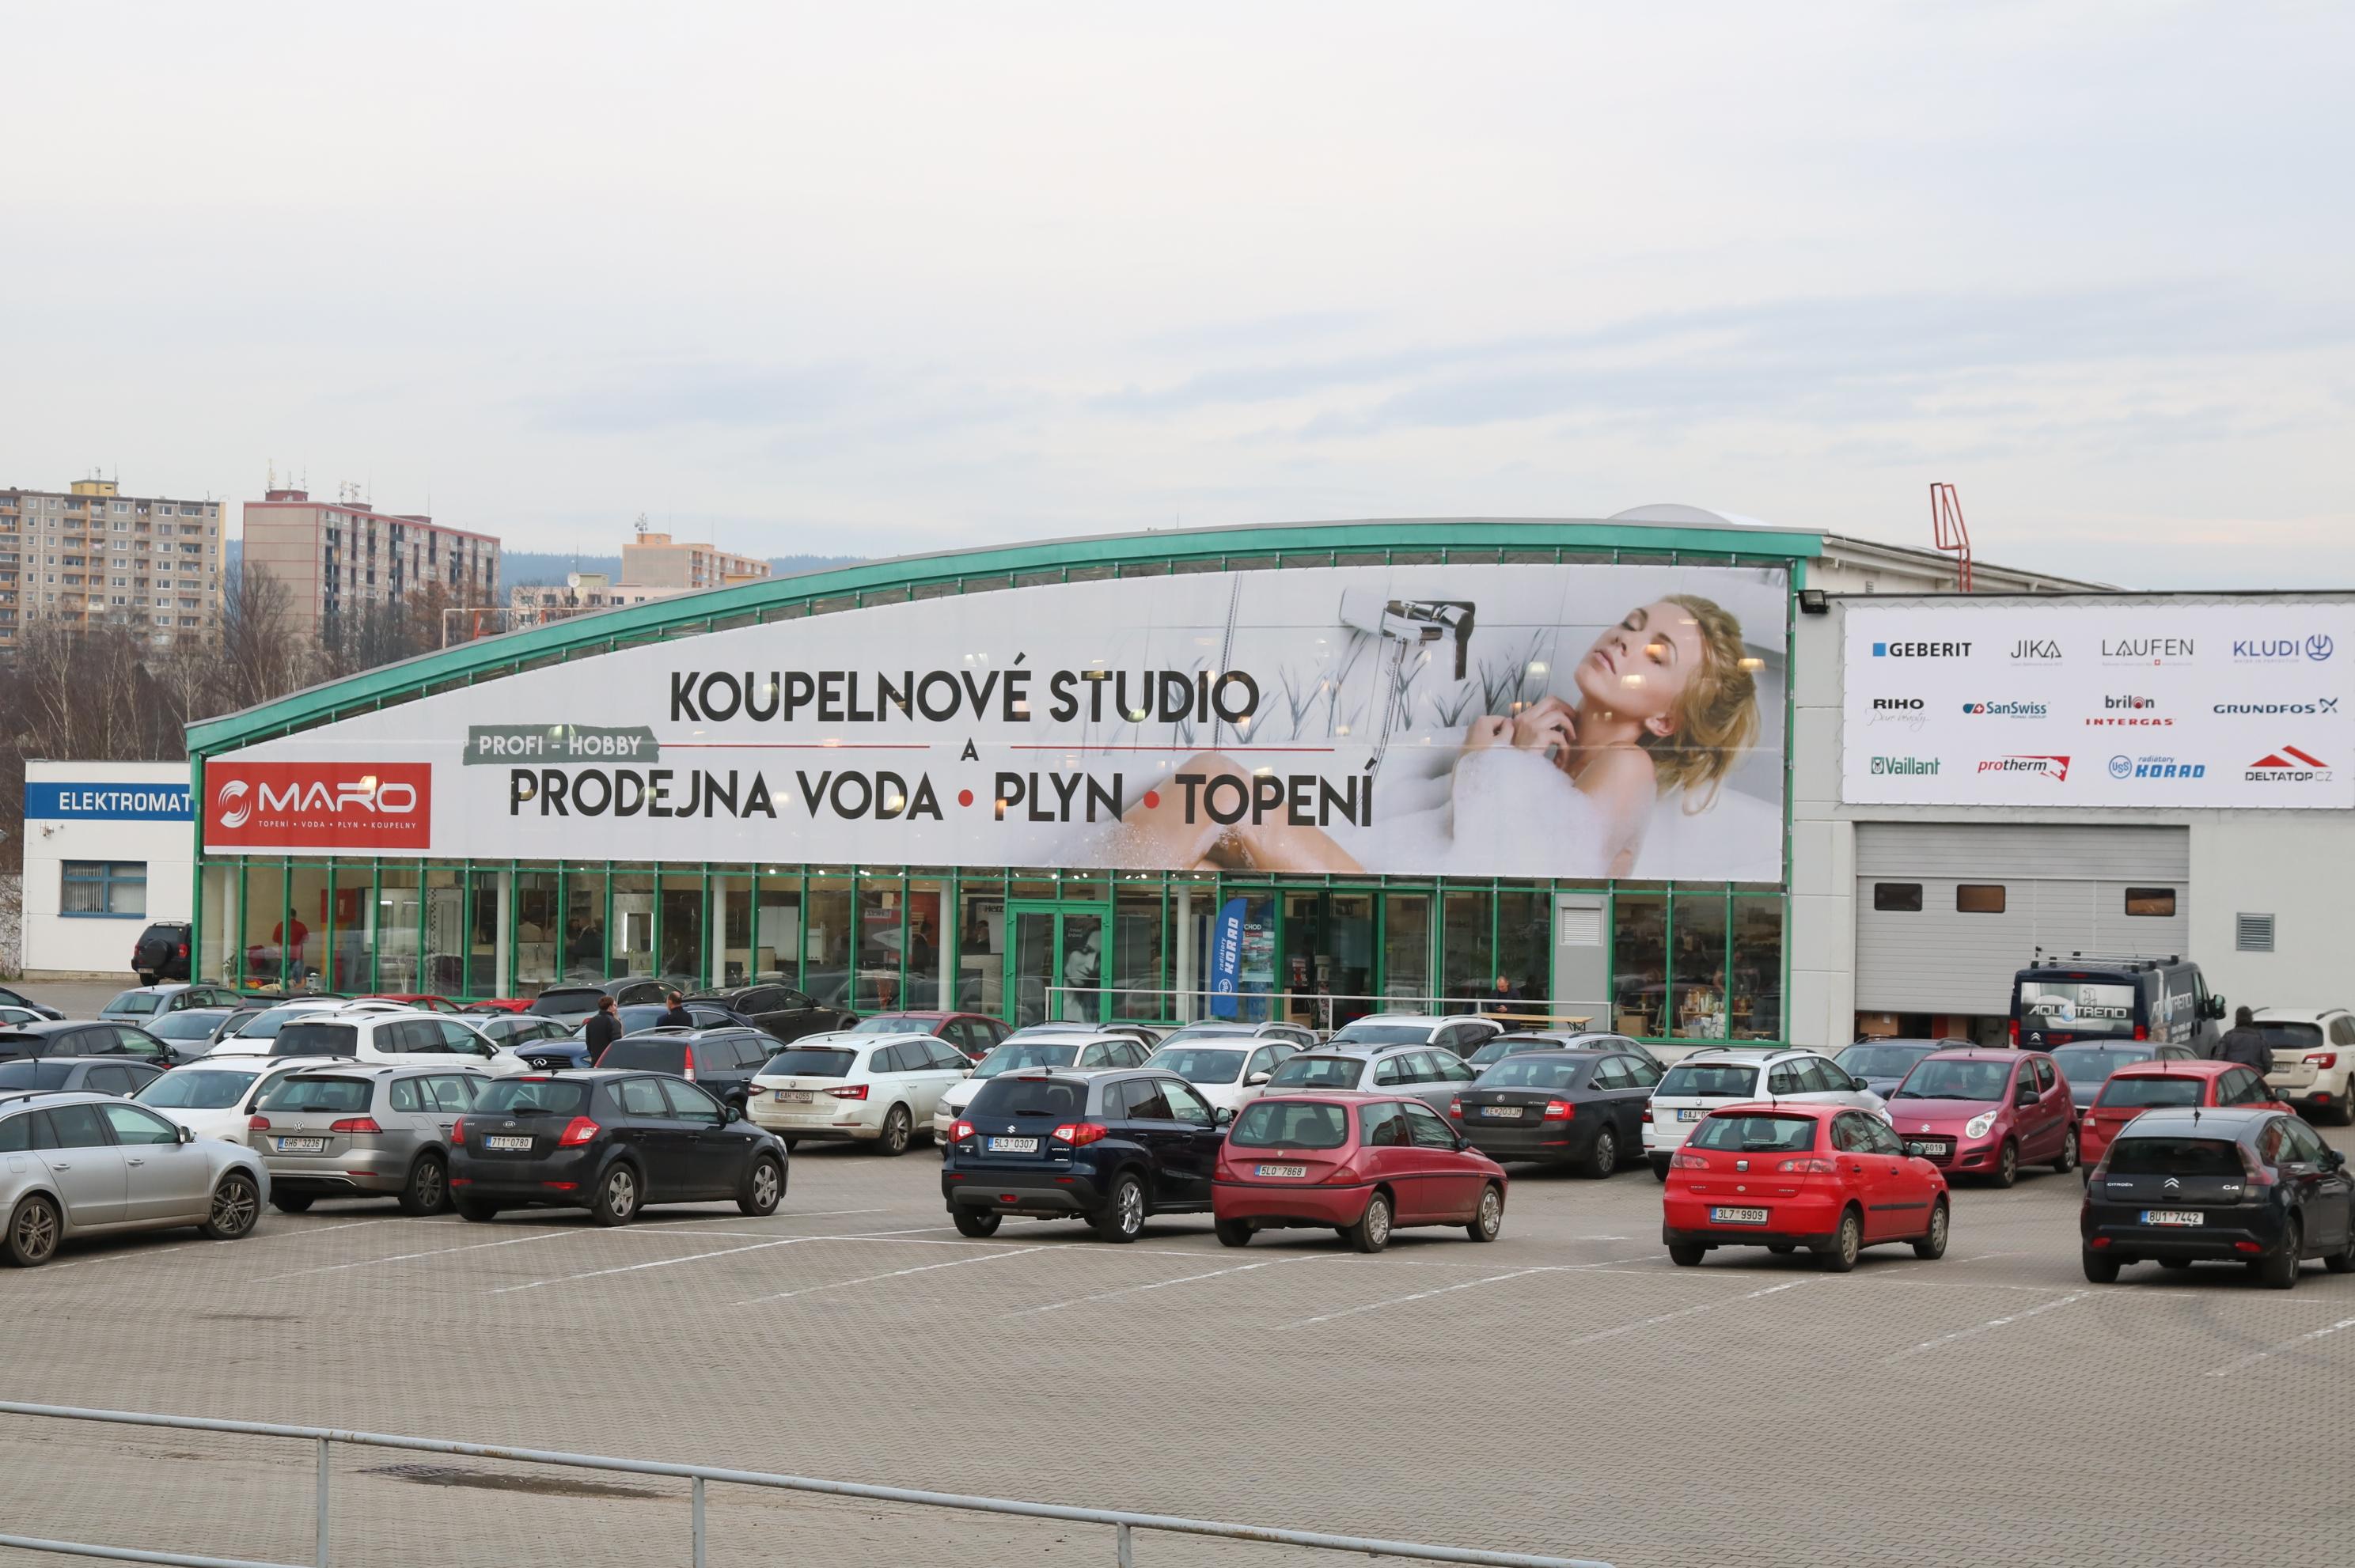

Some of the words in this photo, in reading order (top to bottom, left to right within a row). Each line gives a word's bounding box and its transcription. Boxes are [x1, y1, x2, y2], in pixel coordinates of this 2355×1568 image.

[1890, 642, 1972, 657] GEBERIT
[2011, 640, 2062, 658] JIKA
[2103, 639, 2194, 657] LAUFEN
[2234, 640, 2300, 657] KLUDI
[670, 651, 1032, 723] KOUPELNOVÉ
[1049, 669, 1260, 724] STUDIO
[1873, 699, 1925, 710] RIHO
[1986, 701, 2047, 714] SanSwiss
[2213, 704, 2316, 714] GRUNDFOS
[2086, 718, 2174, 726] INTERGAS
[480, 735, 544, 756] PROFI
[570, 735, 643, 756] HOBBY
[960, 737, 980, 761] A
[1886, 756, 1940, 775] Vaillant
[1978, 758, 2048, 774] protherm
[2138, 755, 2175, 764] radiatory
[2135, 764, 2206, 778] KORAD
[259, 781, 416, 813] MARO
[510, 768, 777, 819] PRODEJNA
[796, 770, 944, 821] VODA
[995, 771, 1123, 823] PLYN
[1175, 756, 1377, 828] TOPENÍ
[59, 791, 191, 813] ELEKTROMAT
[371, 821, 417, 830] KOUPELNY
[1224, 917, 1239, 975] KORAD
[285, 1138, 298, 1147] 6H6
[302, 1139, 320, 1148] 3236
[492, 1138, 506, 1147] 7T1
[510, 1138, 529, 1147] 0780
[995, 1138, 1009, 1147] 5L3
[1014, 1139, 1034, 1148] 0307
[1282, 1167, 1303, 1176] 7868
[1718, 1209, 1735, 1219] 3L7
[1741, 1210, 1763, 1220] 9909
[2149, 1212, 2167, 1222] 8U1
[2175, 1212, 2199, 1223] 7442
